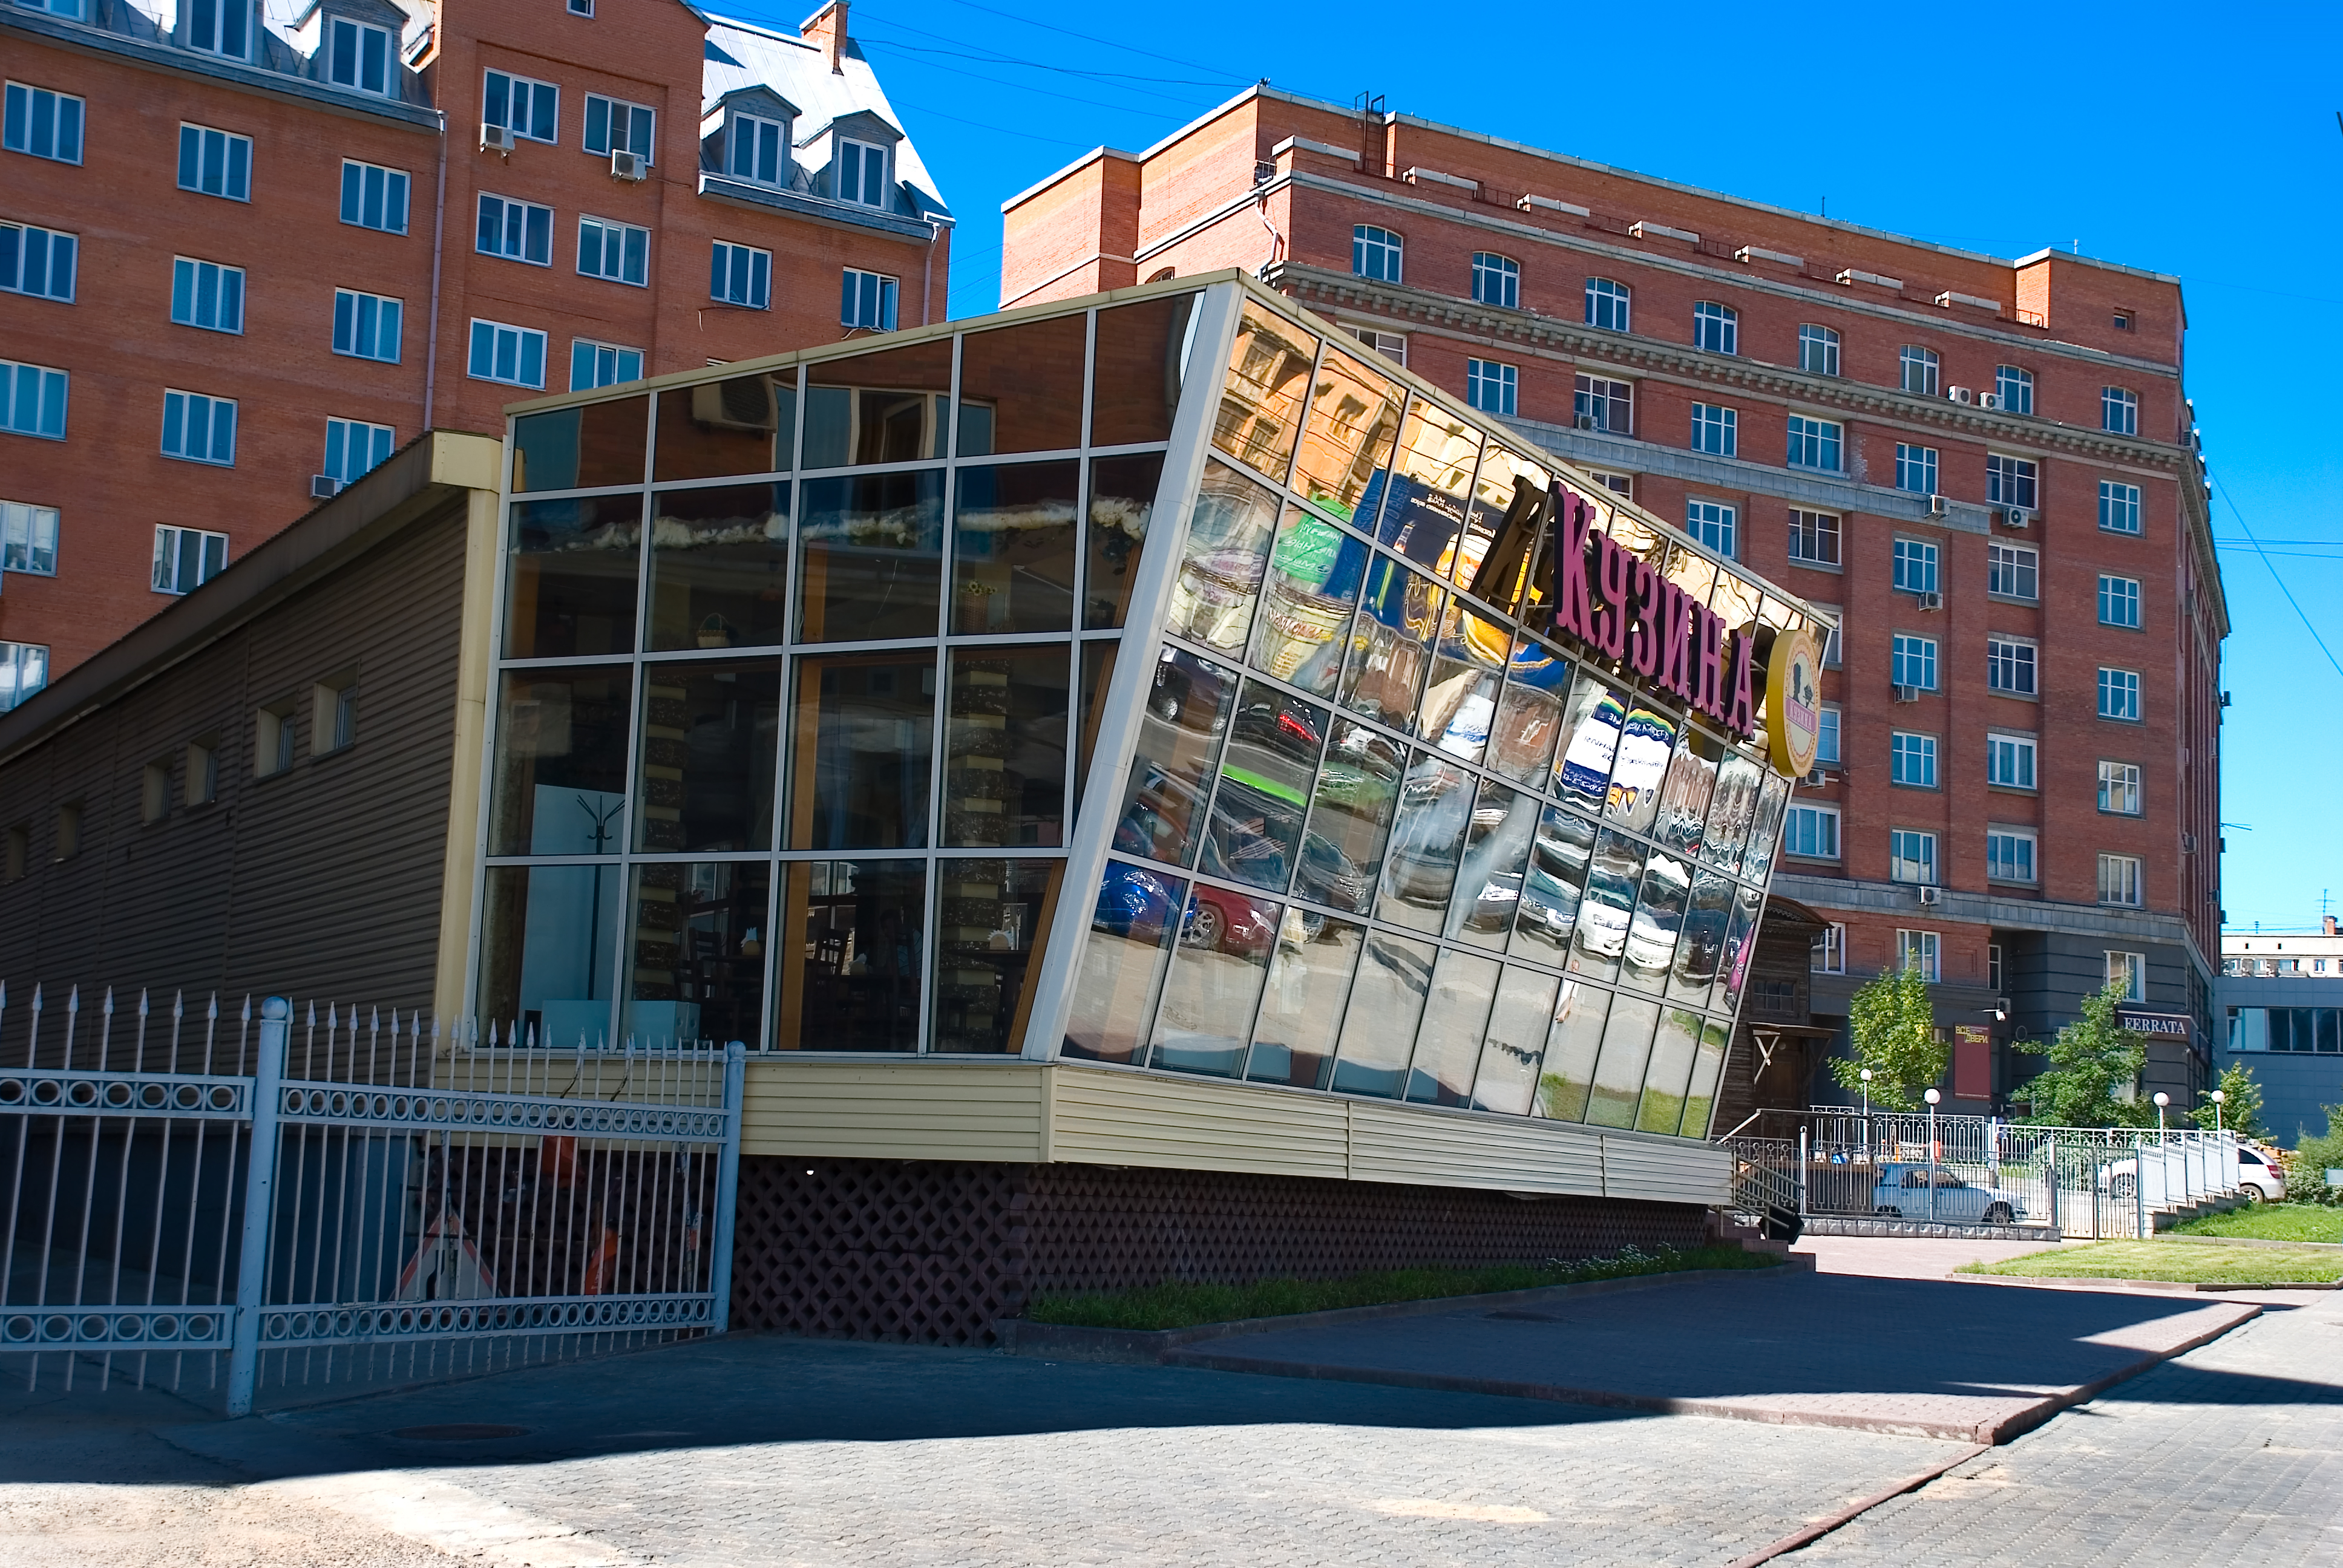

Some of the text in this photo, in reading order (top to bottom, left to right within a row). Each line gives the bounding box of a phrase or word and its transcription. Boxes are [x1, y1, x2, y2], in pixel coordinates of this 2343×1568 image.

[1548, 480, 1755, 740] КУЗИНА
[1789, 701, 1812, 731] КУЗИНА
[1955, 1025, 1971, 1035] ВСЕ
[2124, 1017, 2186, 1034] FERRATA
[1964, 1034, 1988, 1044] ДВЕРИ
